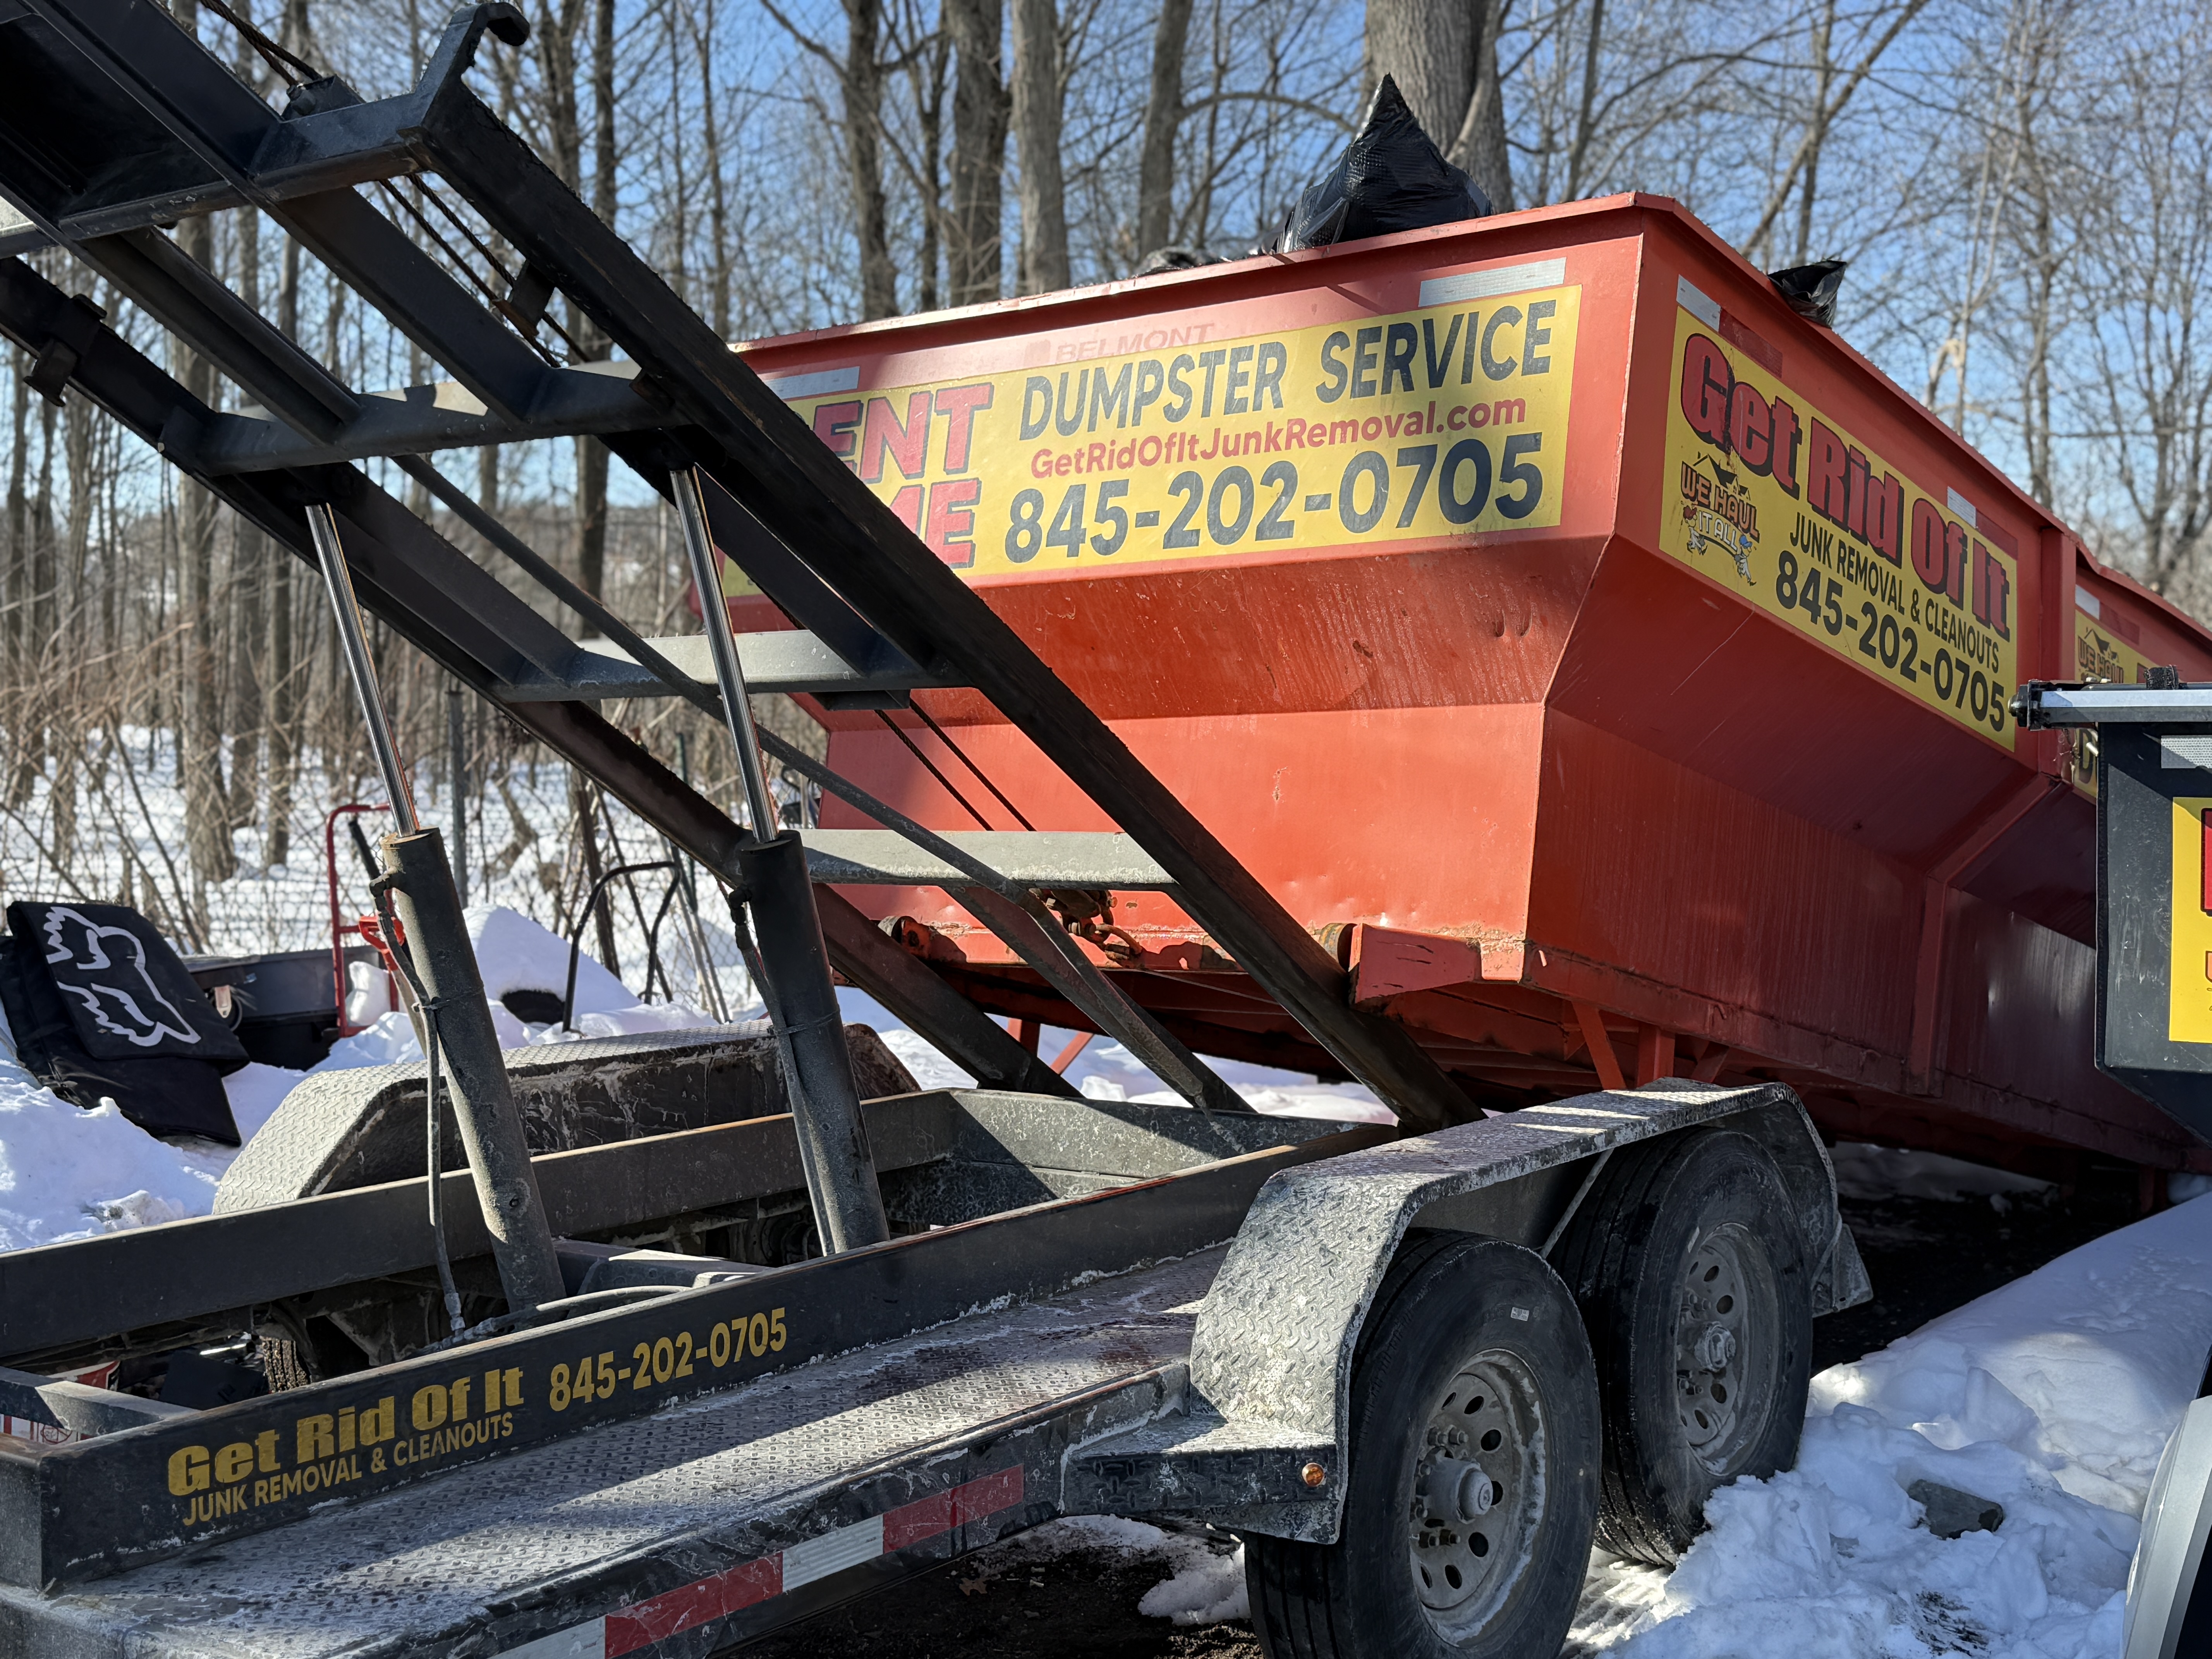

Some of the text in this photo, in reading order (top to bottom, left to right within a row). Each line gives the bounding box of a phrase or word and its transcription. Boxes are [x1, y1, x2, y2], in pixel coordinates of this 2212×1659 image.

[1020, 300, 1556, 441] DUMPSTER SERVICE
[1056, 323, 1214, 362] BELMONT
[813, 382, 994, 483] ENT
[1031, 398, 1525, 478] GetRidOfItJunkRemoval.com
[1681, 333, 2009, 642] Get Rid Of It
[1005, 432, 1542, 563] 845-202-0705
[1681, 461, 1760, 543] WE HAUL
[1699, 510, 1738, 553] IT ALL
[1776, 550, 2004, 732] 845-202-0705
[1790, 512, 1999, 673] JUNK REMOVAL & CLEANOUTS
[2078, 635, 2096, 673] WE
[168, 1307, 787, 1496] Get Rid Of It 845-202-0705
[183, 1412, 514, 1526] JUNK REMOVAL & CLEANOUTS
